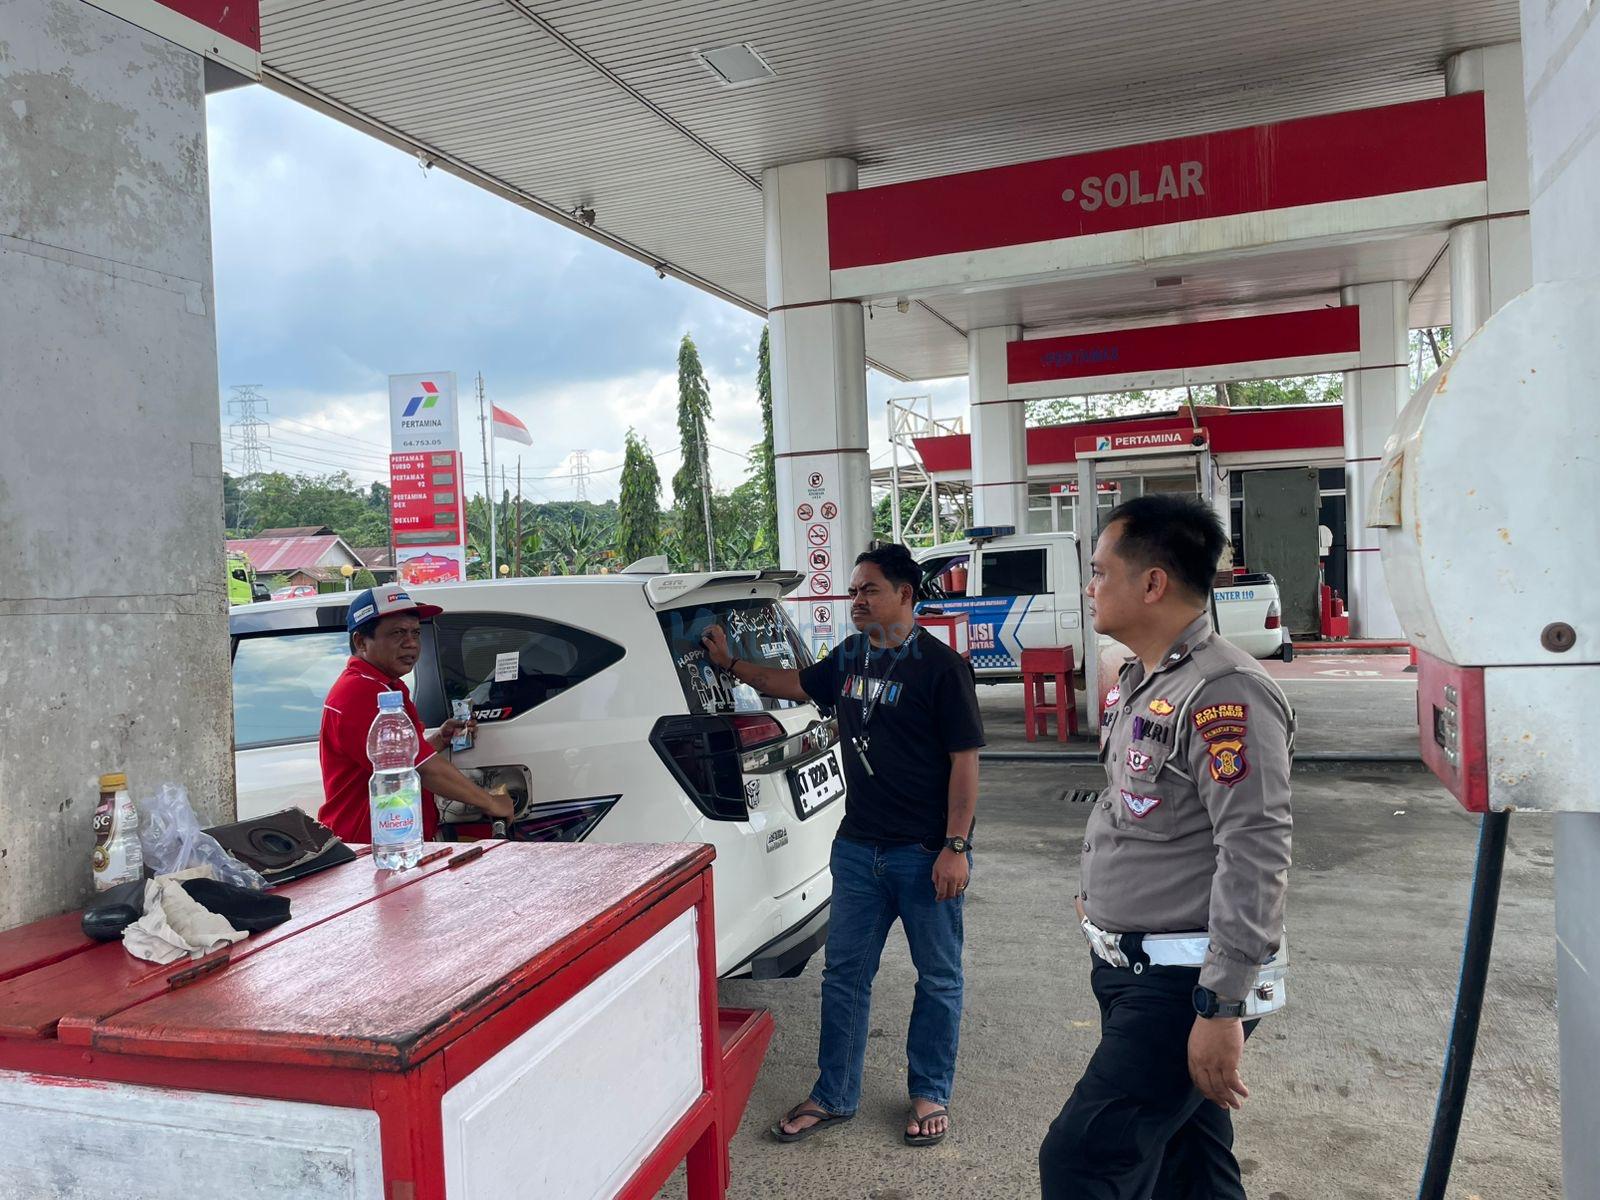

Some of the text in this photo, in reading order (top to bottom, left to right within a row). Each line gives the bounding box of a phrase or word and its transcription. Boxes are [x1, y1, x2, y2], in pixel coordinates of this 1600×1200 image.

[1079, 160, 1206, 212] SOLAR
[401, 419, 442, 428] PERTAMINA
[1115, 432, 1182, 446] PERTAMINA
[392, 473, 425, 481] PERTAMAX
[394, 516, 420, 524] DEXLITE
[1214, 590, 1255, 601] ENTER 110
[968, 623, 994, 641] LISI
[677, 650, 705, 668] HAPPY
[1195, 704, 1243, 720] POLRES
[1196, 710, 1244, 726] KUTAI TIMUR
[808, 762, 829, 789] 1220
[379, 816, 413, 829] Minerale
[390, 813, 401, 821] Le
